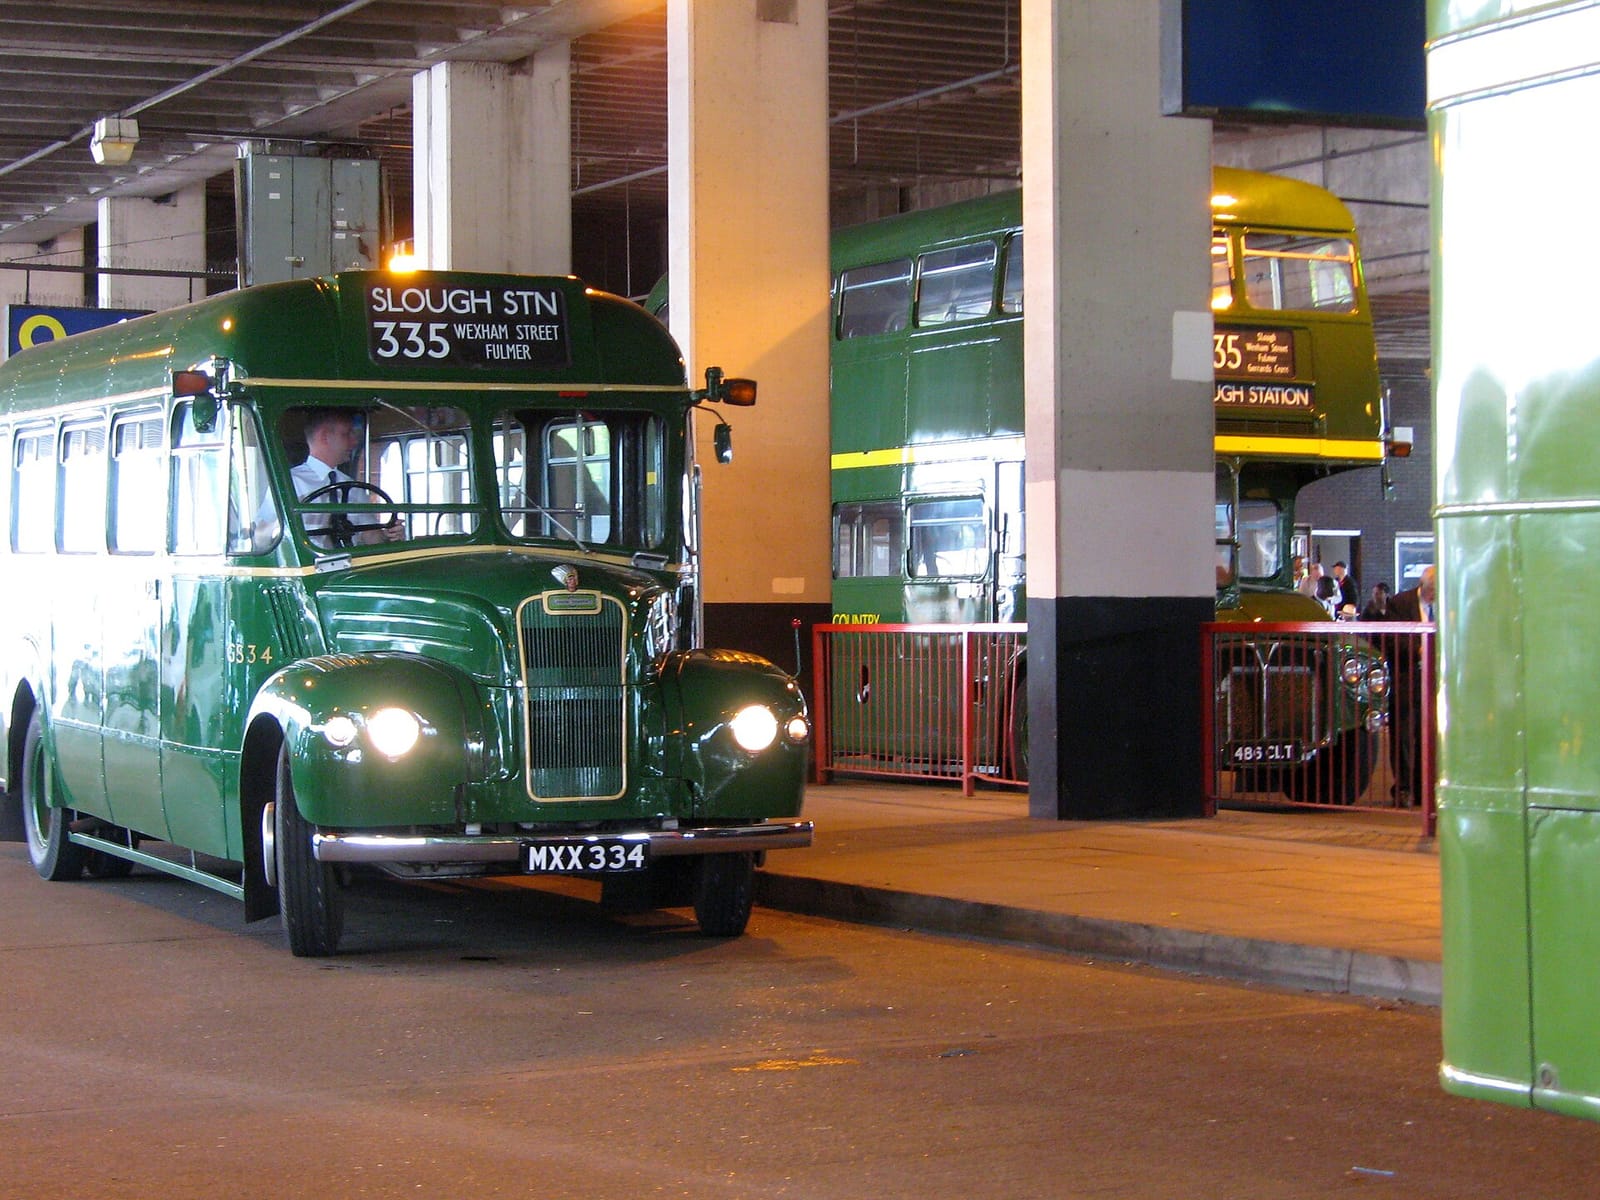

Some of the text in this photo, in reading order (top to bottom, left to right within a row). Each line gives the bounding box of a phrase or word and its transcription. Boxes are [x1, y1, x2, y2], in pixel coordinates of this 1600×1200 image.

[371, 287, 558, 316] SLOUGH STN
[373, 321, 450, 359] 335
[453, 323, 559, 341] WEXHAM STREET
[485, 344, 532, 360] FULMER
[1248, 385, 1309, 406] STATION
[528, 843, 645, 871] MXX 334
